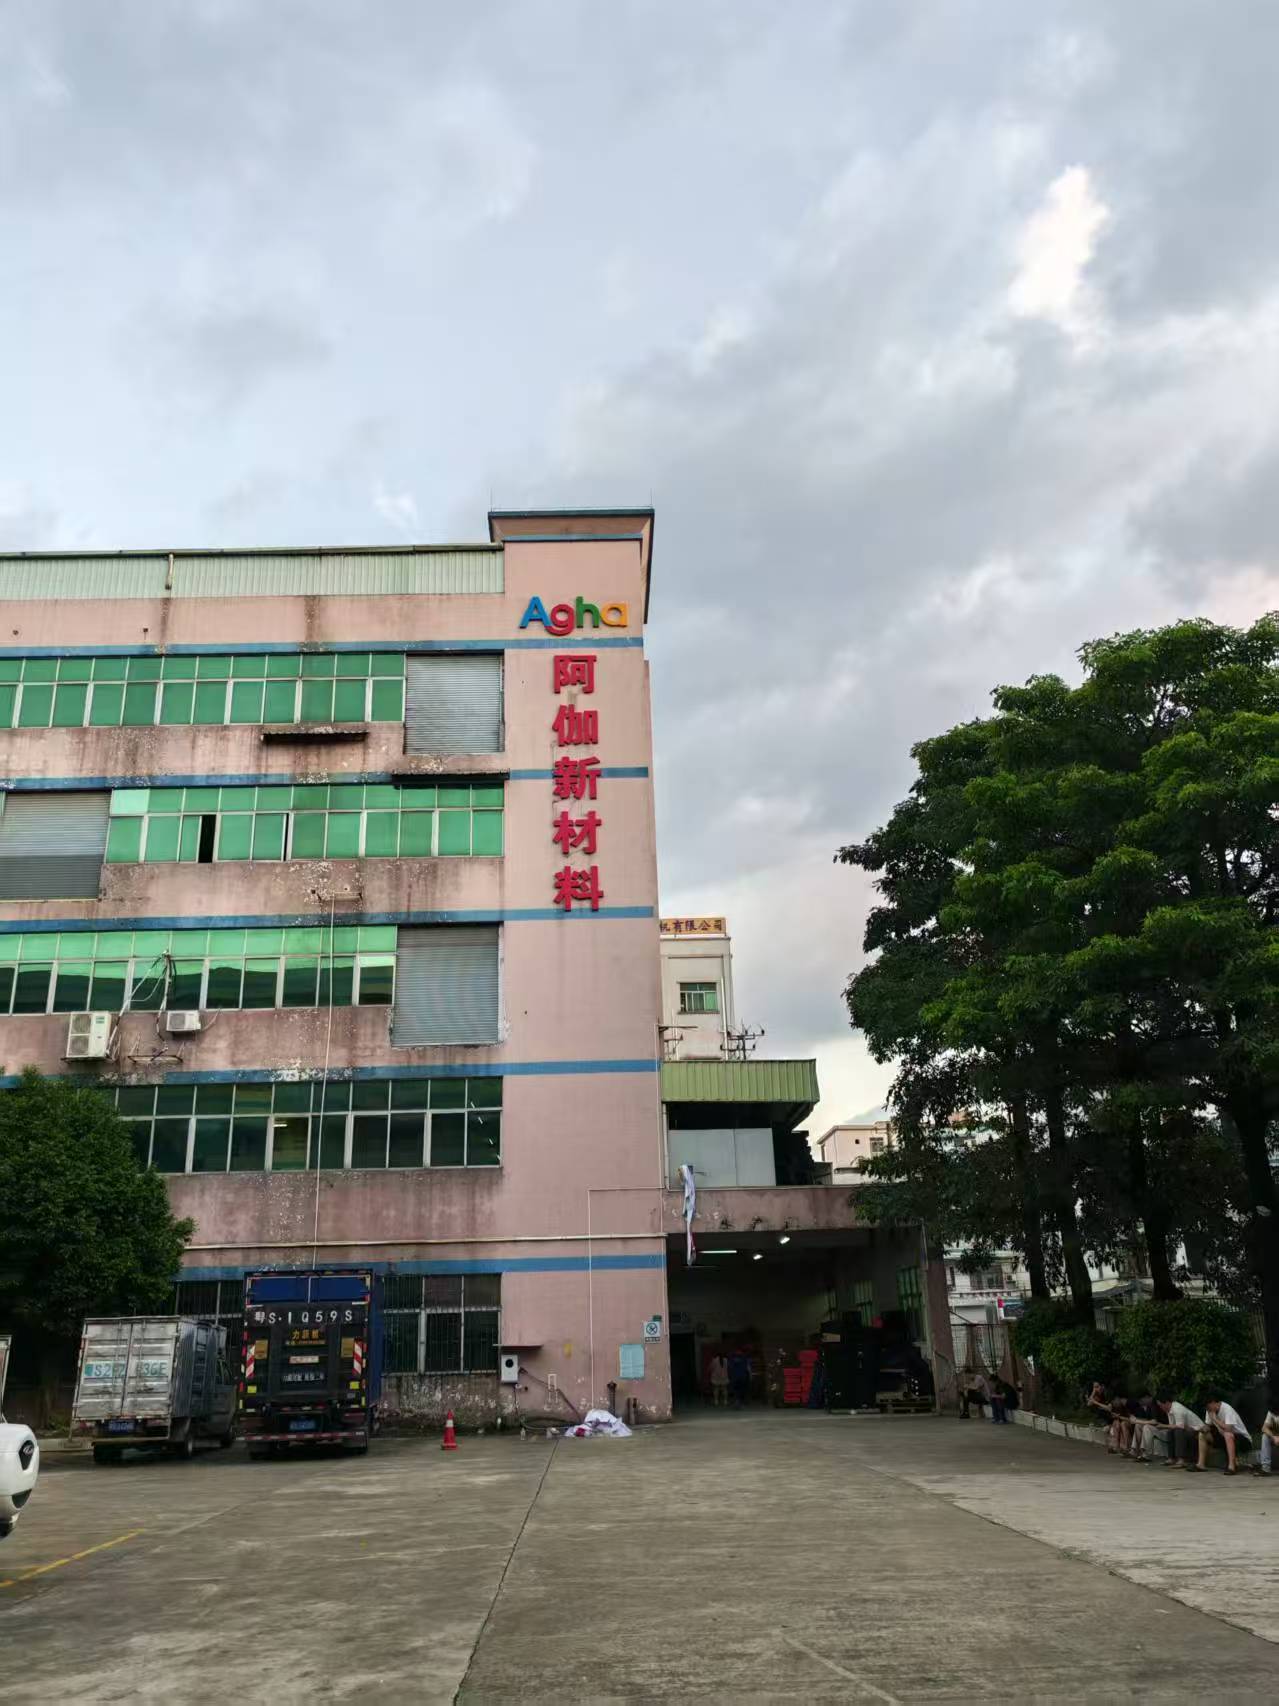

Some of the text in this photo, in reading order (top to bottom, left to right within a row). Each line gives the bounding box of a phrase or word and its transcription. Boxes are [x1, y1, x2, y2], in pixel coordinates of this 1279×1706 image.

[519, 596, 628, 635] Agha
[552, 655, 604, 912] 阿伽新材料
